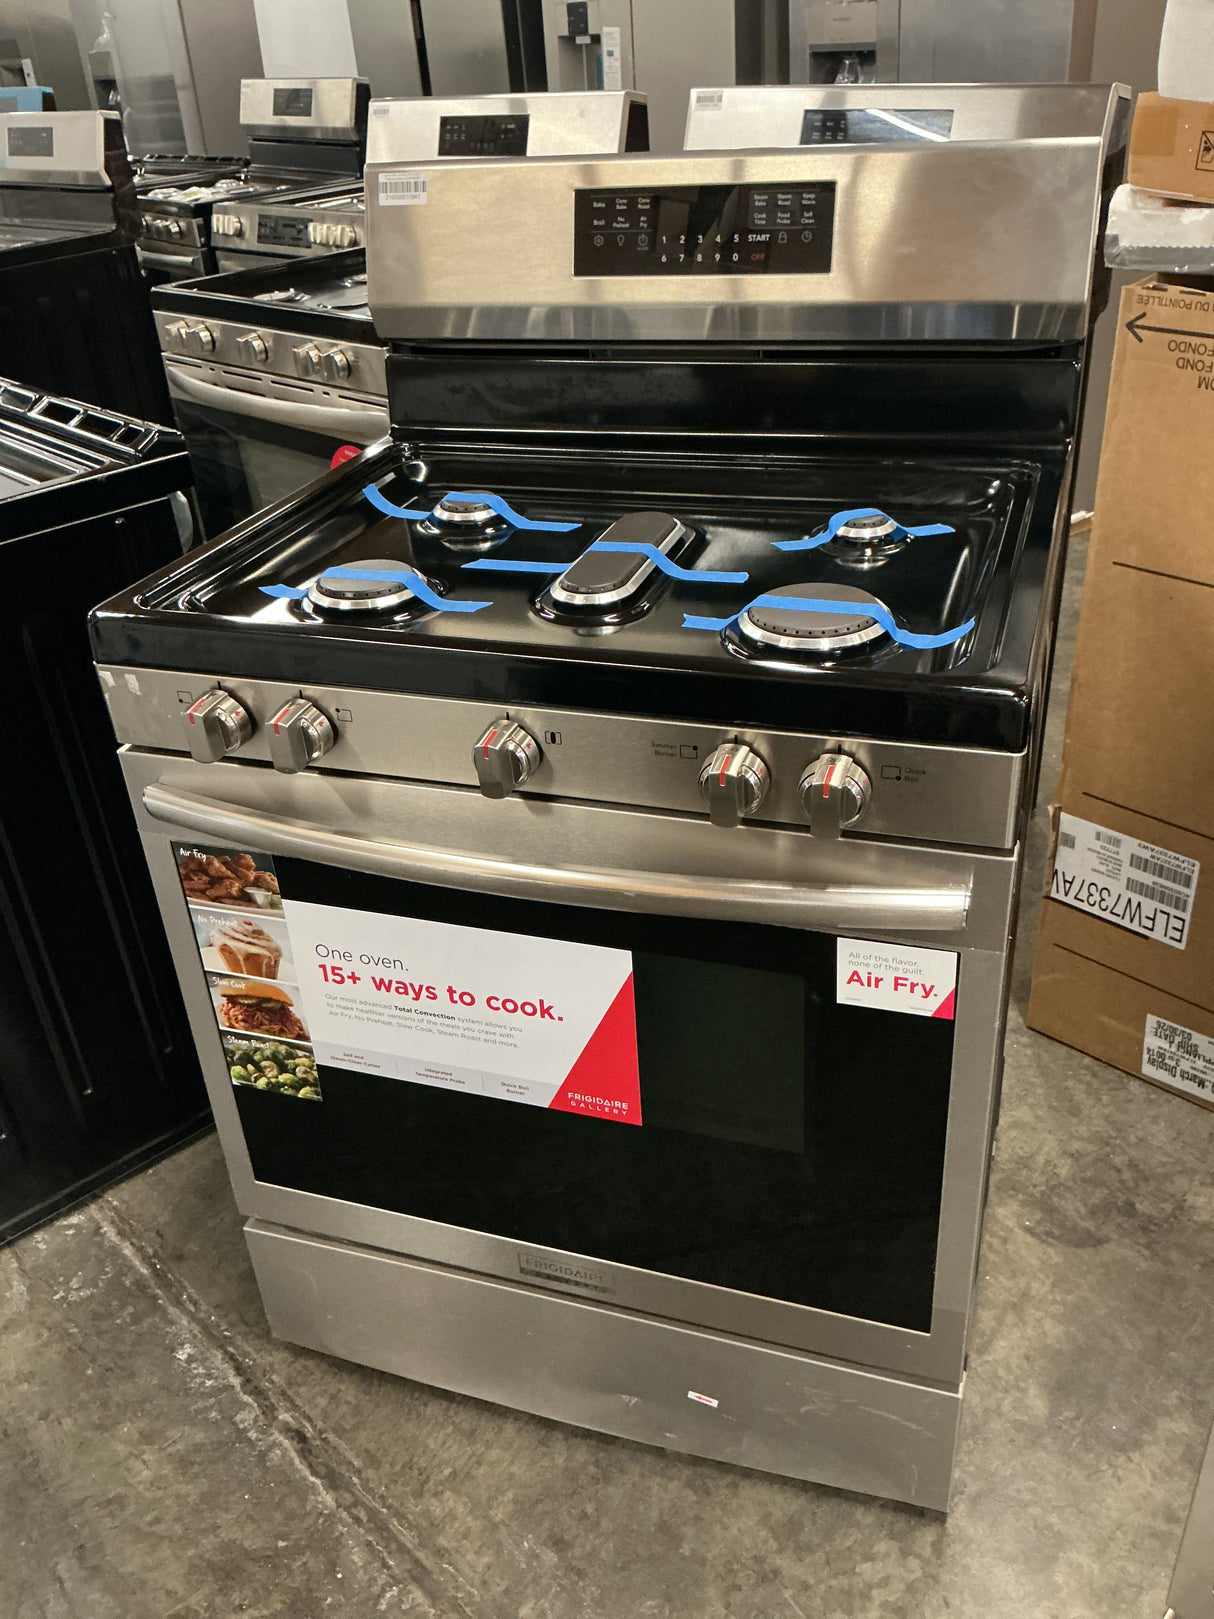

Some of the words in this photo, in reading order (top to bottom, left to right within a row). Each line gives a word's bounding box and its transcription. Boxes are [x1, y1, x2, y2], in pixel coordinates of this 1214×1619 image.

[661, 235, 667, 244] 1
[679, 235, 686, 244] 2
[697, 235, 703, 244] 3
[715, 234, 721, 243] 4
[733, 234, 739, 243] 5
[747, 233, 771, 242] START
[661, 254, 667, 263] 6
[679, 253, 685, 262] 7
[696, 253, 702, 262] 8
[714, 253, 720, 262] 9
[732, 252, 739, 261] 0
[1136, 294, 1193, 310] POINTILLÉE
[1194, 301, 1210, 312] DU
[1167, 339, 1214, 357] FONDO
[1175, 356, 1213, 373] FOND
[654, 750, 677, 758] Burner
[179, 847, 192, 857] Air
[193, 849, 207, 863] Fry
[197, 915, 208, 924] No
[209, 916, 238, 928] Preheat
[315, 943, 353, 962] One
[359, 953, 409, 972] oven.
[848, 951, 861, 959] All
[874, 955, 890, 963] the
[848, 960, 871, 968] none
[872, 962, 882, 970] of
[885, 964, 900, 972] the
[902, 967, 925, 976] guilt.
[212, 976, 229, 986] Slow
[230, 980, 247, 990] Cook
[846, 970, 884, 989] Air
[893, 976, 938, 999] Fry.
[318, 964, 361, 985] 15+
[371, 976, 438, 1001] ways
[447, 985, 476, 1007] to
[485, 995, 564, 1022] cook.
[325, 993, 338, 1001] Our
[339, 996, 357, 1004] most
[358, 1000, 393, 1010] advanced
[394, 1005, 413, 1014] Total
[414, 1008, 456, 1021] Convection
[457, 1016, 483, 1026] system
[484, 1020, 507, 1030] allows
[356, 1007, 386, 1017] healthier
[387, 1013, 416, 1022] versions
[426, 1018, 438, 1026] the
[439, 1021, 461, 1030] meals
[477, 1028, 497, 1036] crave
[499, 1031, 515, 1039] with
[227, 1035, 249, 1045] Steam
[251, 1039, 270, 1050] Roast
[396, 1021, 413, 1030] Slow
[436, 1029, 460, 1038] Steam
[460, 1033, 482, 1042] Roast
[498, 1041, 520, 1049] more.
[330, 1055, 363, 1066] Steam-Clean
[363, 1061, 381, 1069] Cycles
[1147, 1054, 1177, 1078] Display
[415, 1071, 449, 1082] Temperature
[449, 1077, 466, 1085] Probe
[424, 1067, 453, 1077] Integrated
[500, 1081, 517, 1089] Quick
[506, 1088, 525, 1096] Burner
[567, 1092, 629, 1110] FRIGIDAIRE
[570, 1100, 628, 1116] GALLERY
